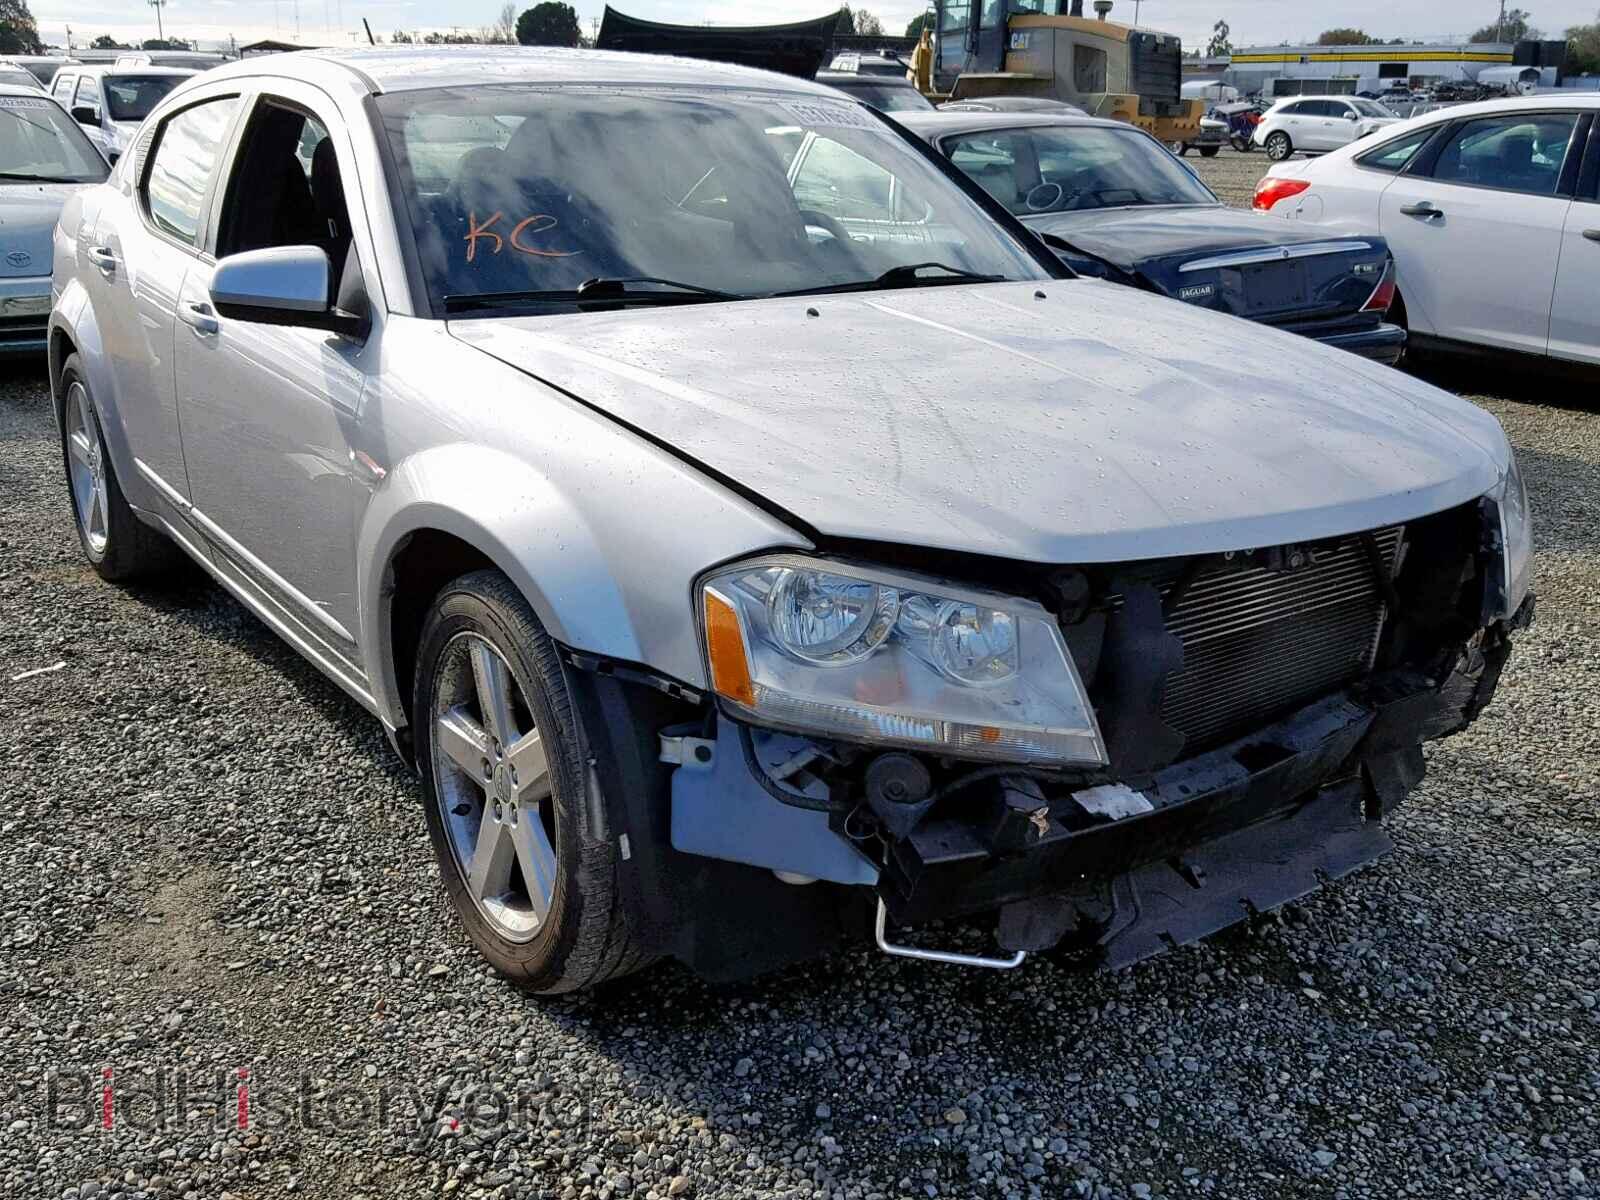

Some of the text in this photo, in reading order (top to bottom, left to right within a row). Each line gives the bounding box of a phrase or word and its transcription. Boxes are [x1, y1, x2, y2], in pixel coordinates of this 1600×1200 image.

[1011, 32, 1030, 49] CAT
[463, 211, 585, 262] KC
[1181, 286, 1211, 298] JAGUAR
